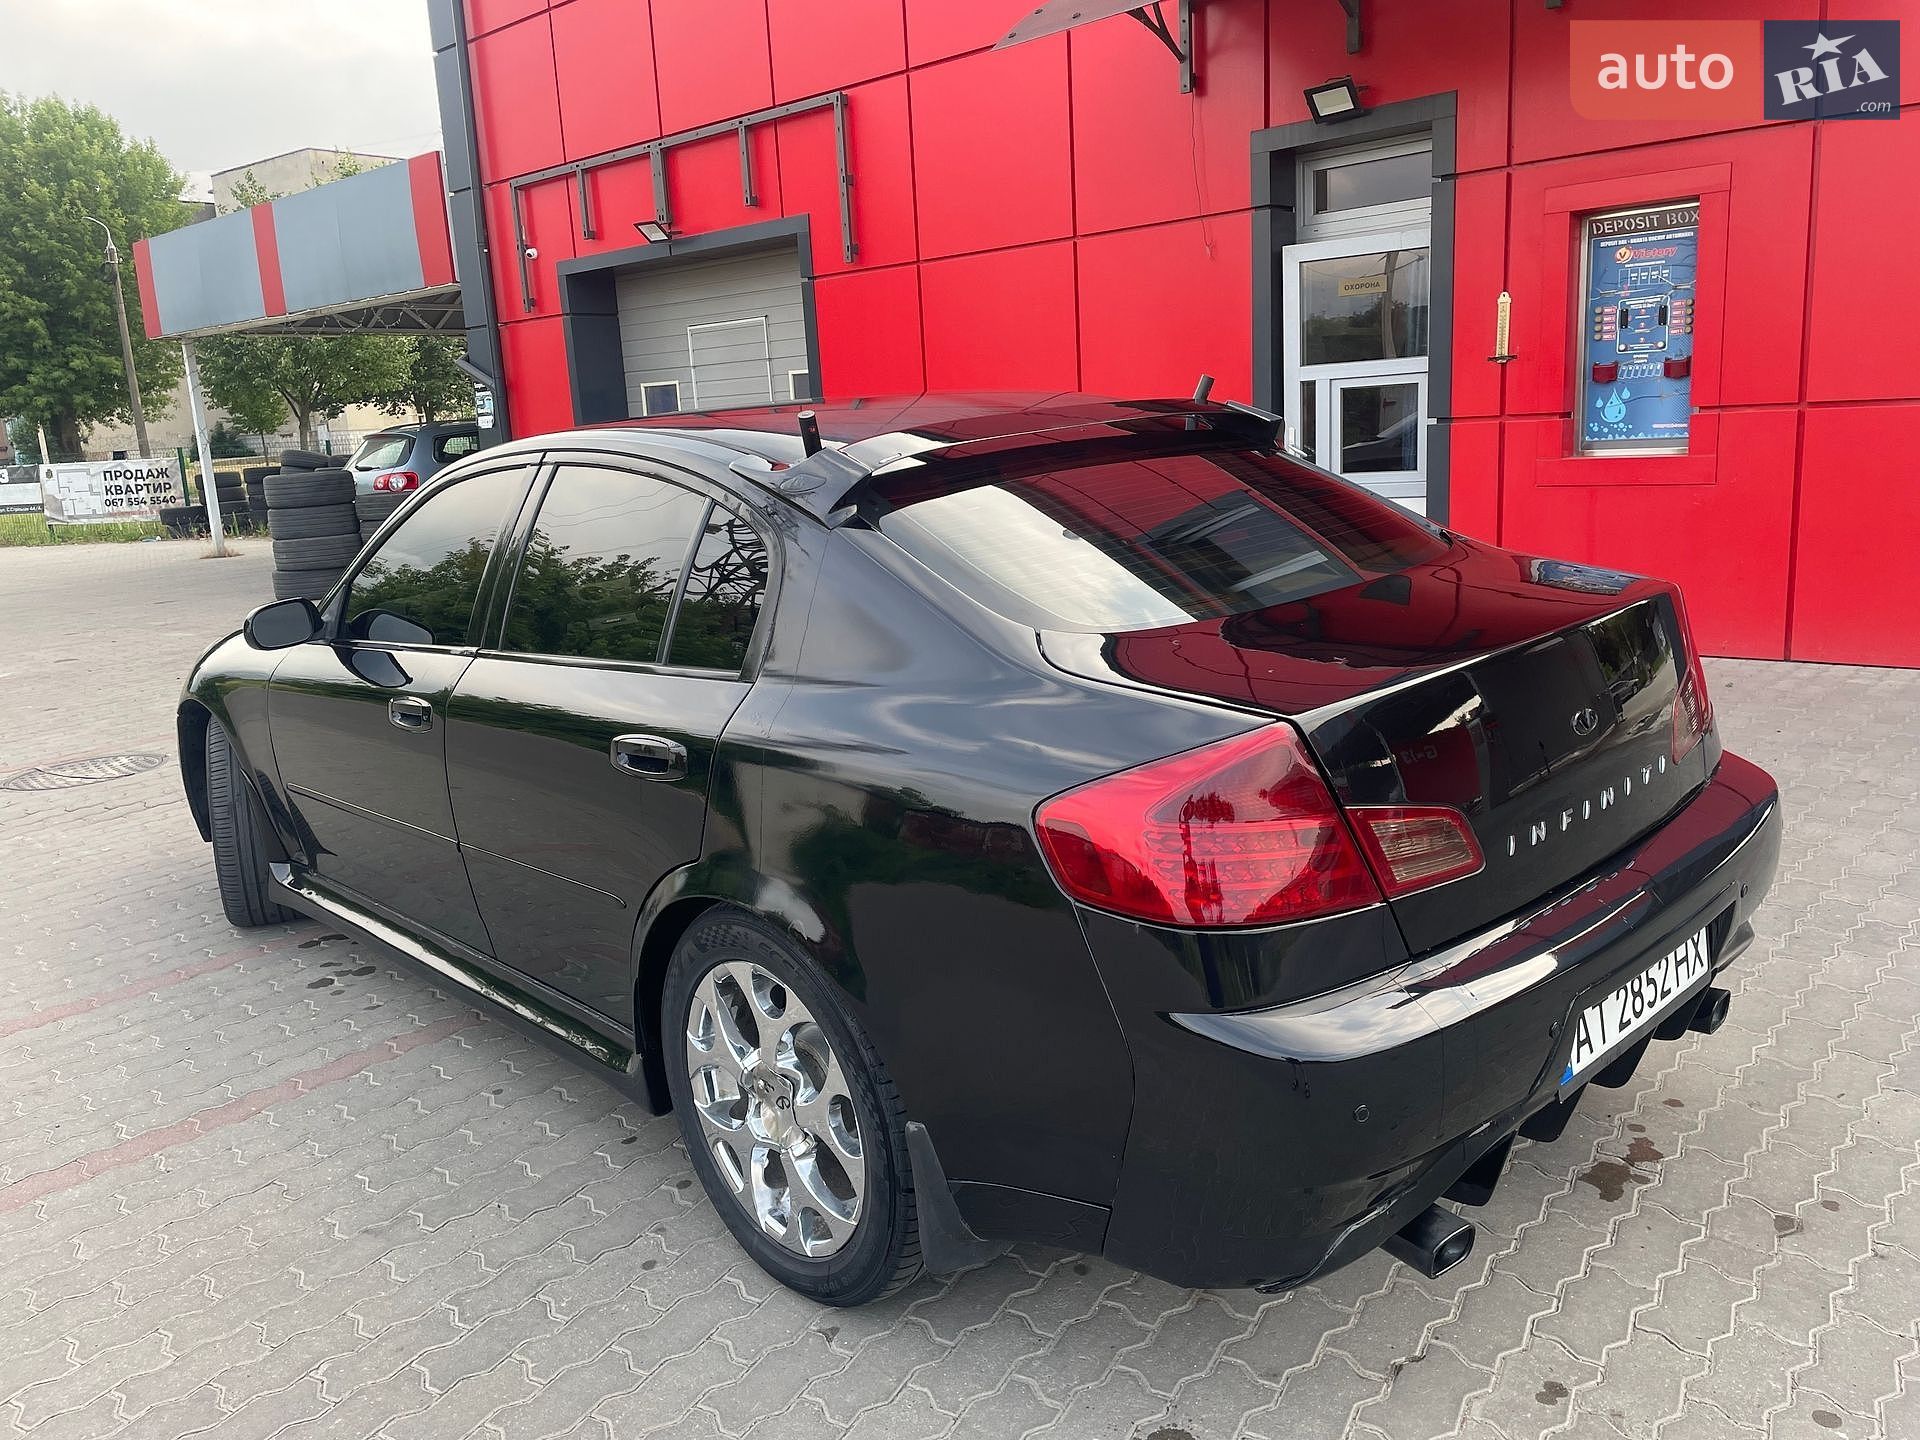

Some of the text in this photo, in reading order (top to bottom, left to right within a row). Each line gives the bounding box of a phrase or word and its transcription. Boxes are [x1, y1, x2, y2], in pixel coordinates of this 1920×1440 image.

[1592, 209, 1699, 235] DEPOSIT BOX
[1344, 281, 1380, 291] ОХОРОНА
[103, 467, 170, 482] ПРОДАЖ
[104, 482, 172, 496] КВАРТИР
[104, 495, 177, 507] 067 554 5540
[1506, 754, 1666, 857] INFINITI
[1576, 929, 1704, 1064] AT 2852 HX
